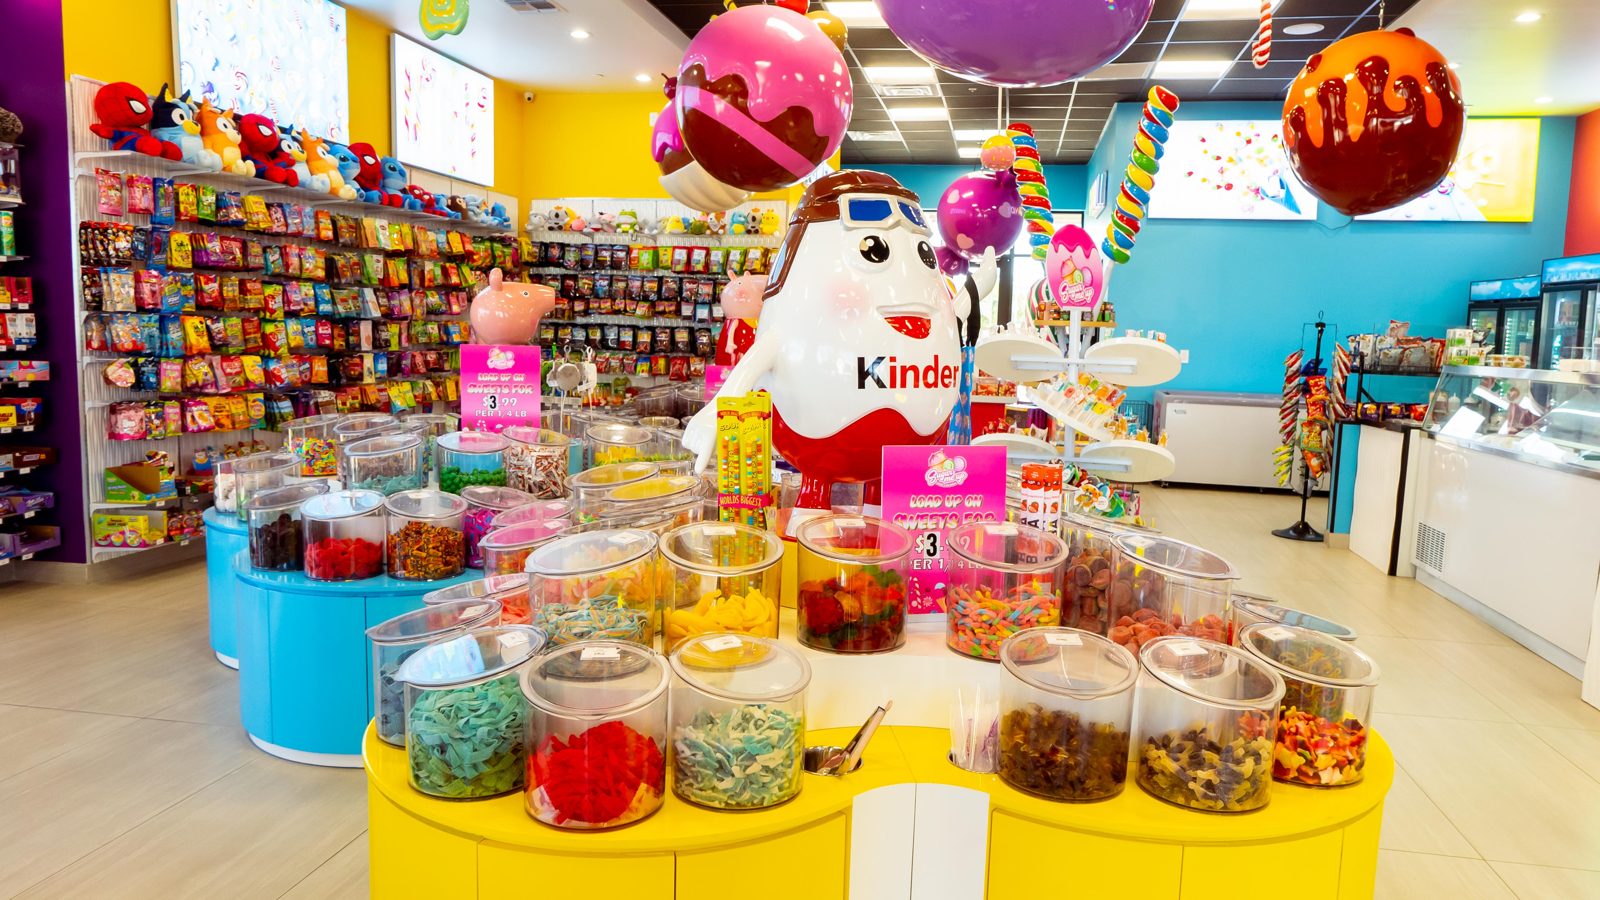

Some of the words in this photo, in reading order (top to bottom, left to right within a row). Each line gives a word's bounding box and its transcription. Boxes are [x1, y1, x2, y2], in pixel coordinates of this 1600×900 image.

[477, 373, 499, 381] LOAD
[500, 373, 511, 381] UP
[513, 373, 525, 381] ON
[857, 354, 960, 390] Kinder
[467, 383, 510, 394] SWEETS
[512, 383, 534, 394] FOR
[482, 395, 518, 409] $3.99
[498, 410, 512, 419] 1/4
[909, 495, 942, 508] LOAD
[944, 495, 963, 508] UP
[965, 495, 984, 508] ON
[893, 511, 959, 529] SWEETS
[962, 511, 996, 524] FOR
[914, 532, 971, 557] $3.9
